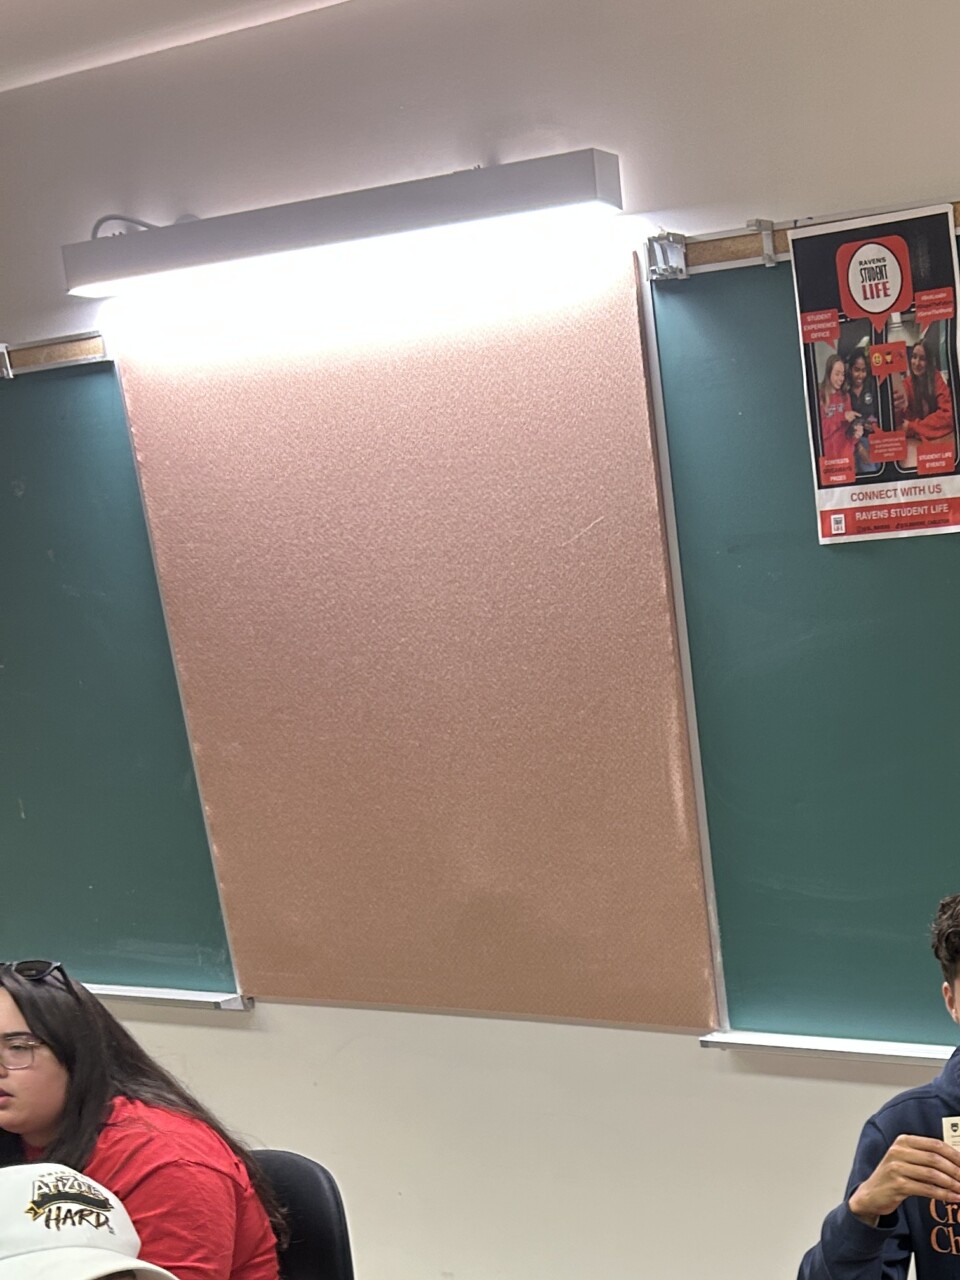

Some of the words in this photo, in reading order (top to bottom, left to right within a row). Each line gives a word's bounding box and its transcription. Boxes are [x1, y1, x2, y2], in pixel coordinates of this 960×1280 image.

[859, 257, 887, 266] RAVENS
[860, 265, 888, 283] STUDENT
[862, 281, 891, 301] LIFE
[807, 313, 832, 322] STUDENT
[811, 331, 830, 339] OFFICE
[851, 489, 899, 502] CONNECT
[900, 486, 926, 499] WITH
[928, 484, 942, 495] US
[856, 510, 889, 521] RAVENS
[890, 507, 928, 519] STUDENT
[931, 503, 950, 514] LIFE
[45, 1206, 109, 1232] HARD
